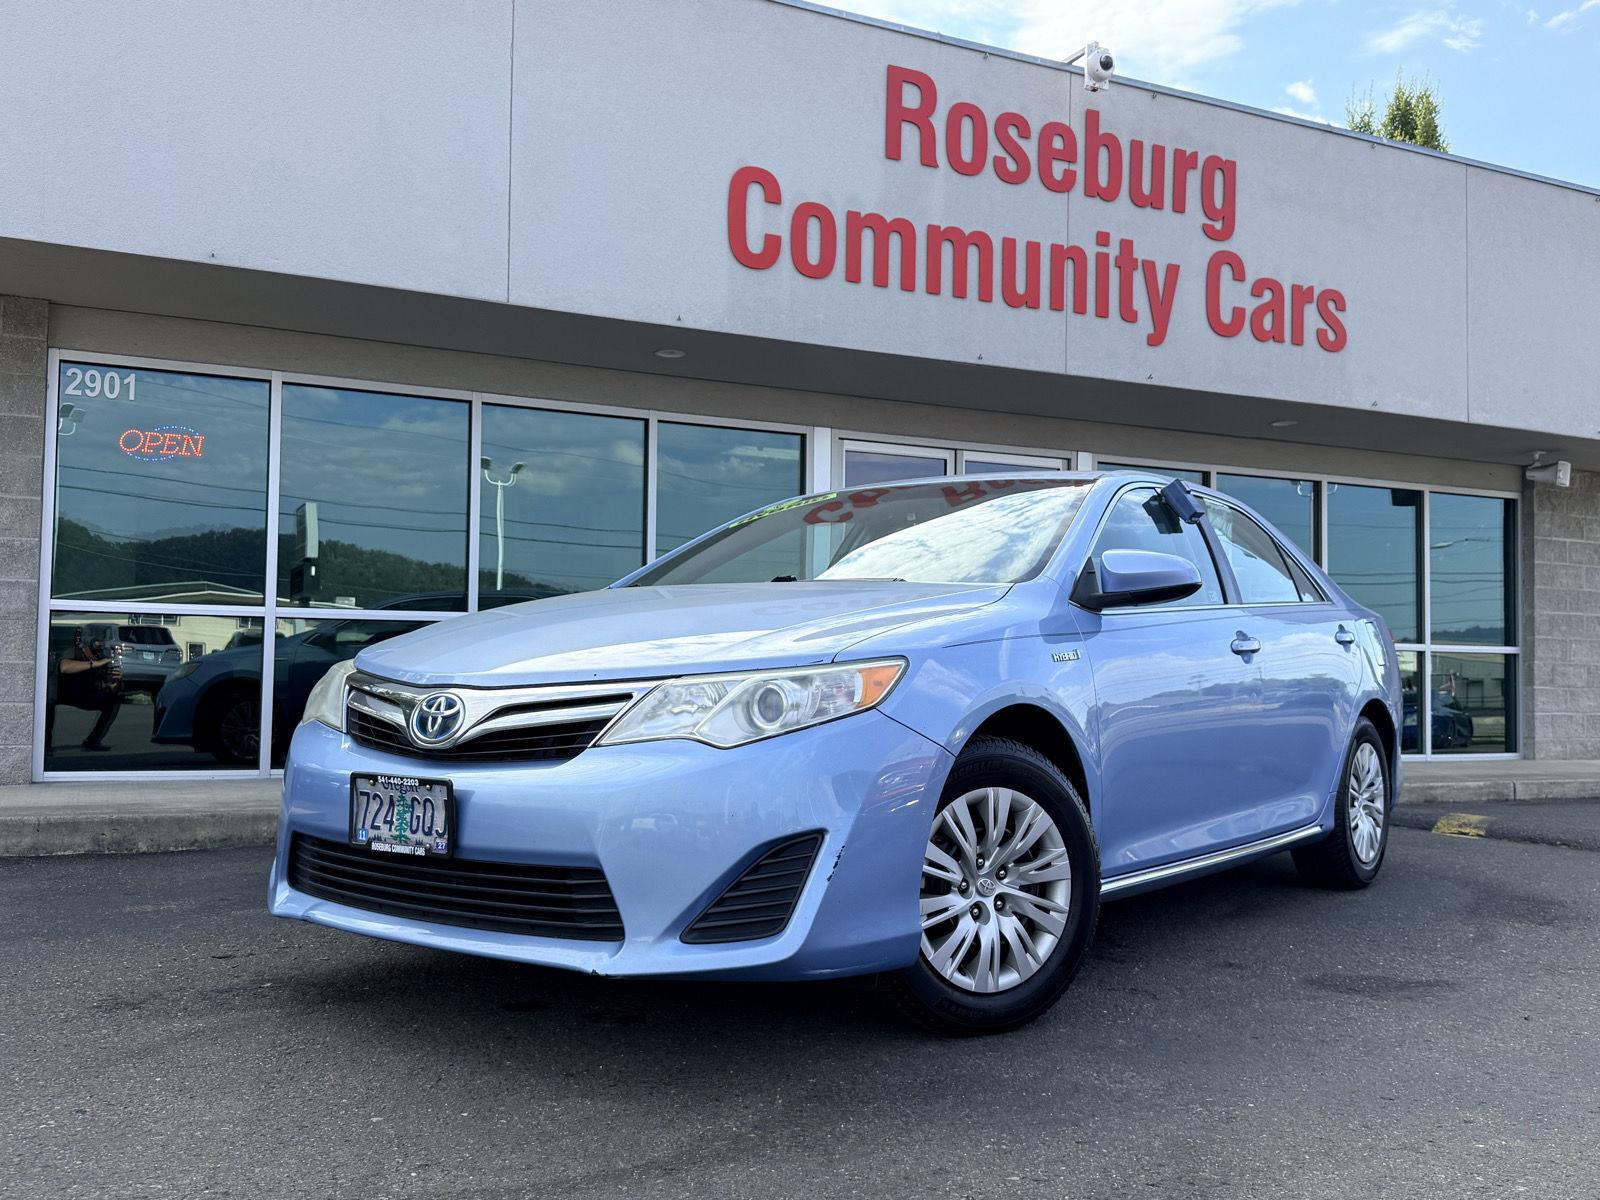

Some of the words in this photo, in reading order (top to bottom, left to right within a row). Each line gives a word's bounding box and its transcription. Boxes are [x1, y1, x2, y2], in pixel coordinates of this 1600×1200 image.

[884, 63, 1237, 241] Roseburg
[727, 165, 1180, 346] Community
[1204, 250, 1347, 353] Cars
[64, 367, 137, 401] 2901
[119, 428, 205, 457] OPEN
[377, 775, 419, 787] 541-440-2203
[359, 789, 395, 832] 724
[409, 795, 448, 838] GQJ
